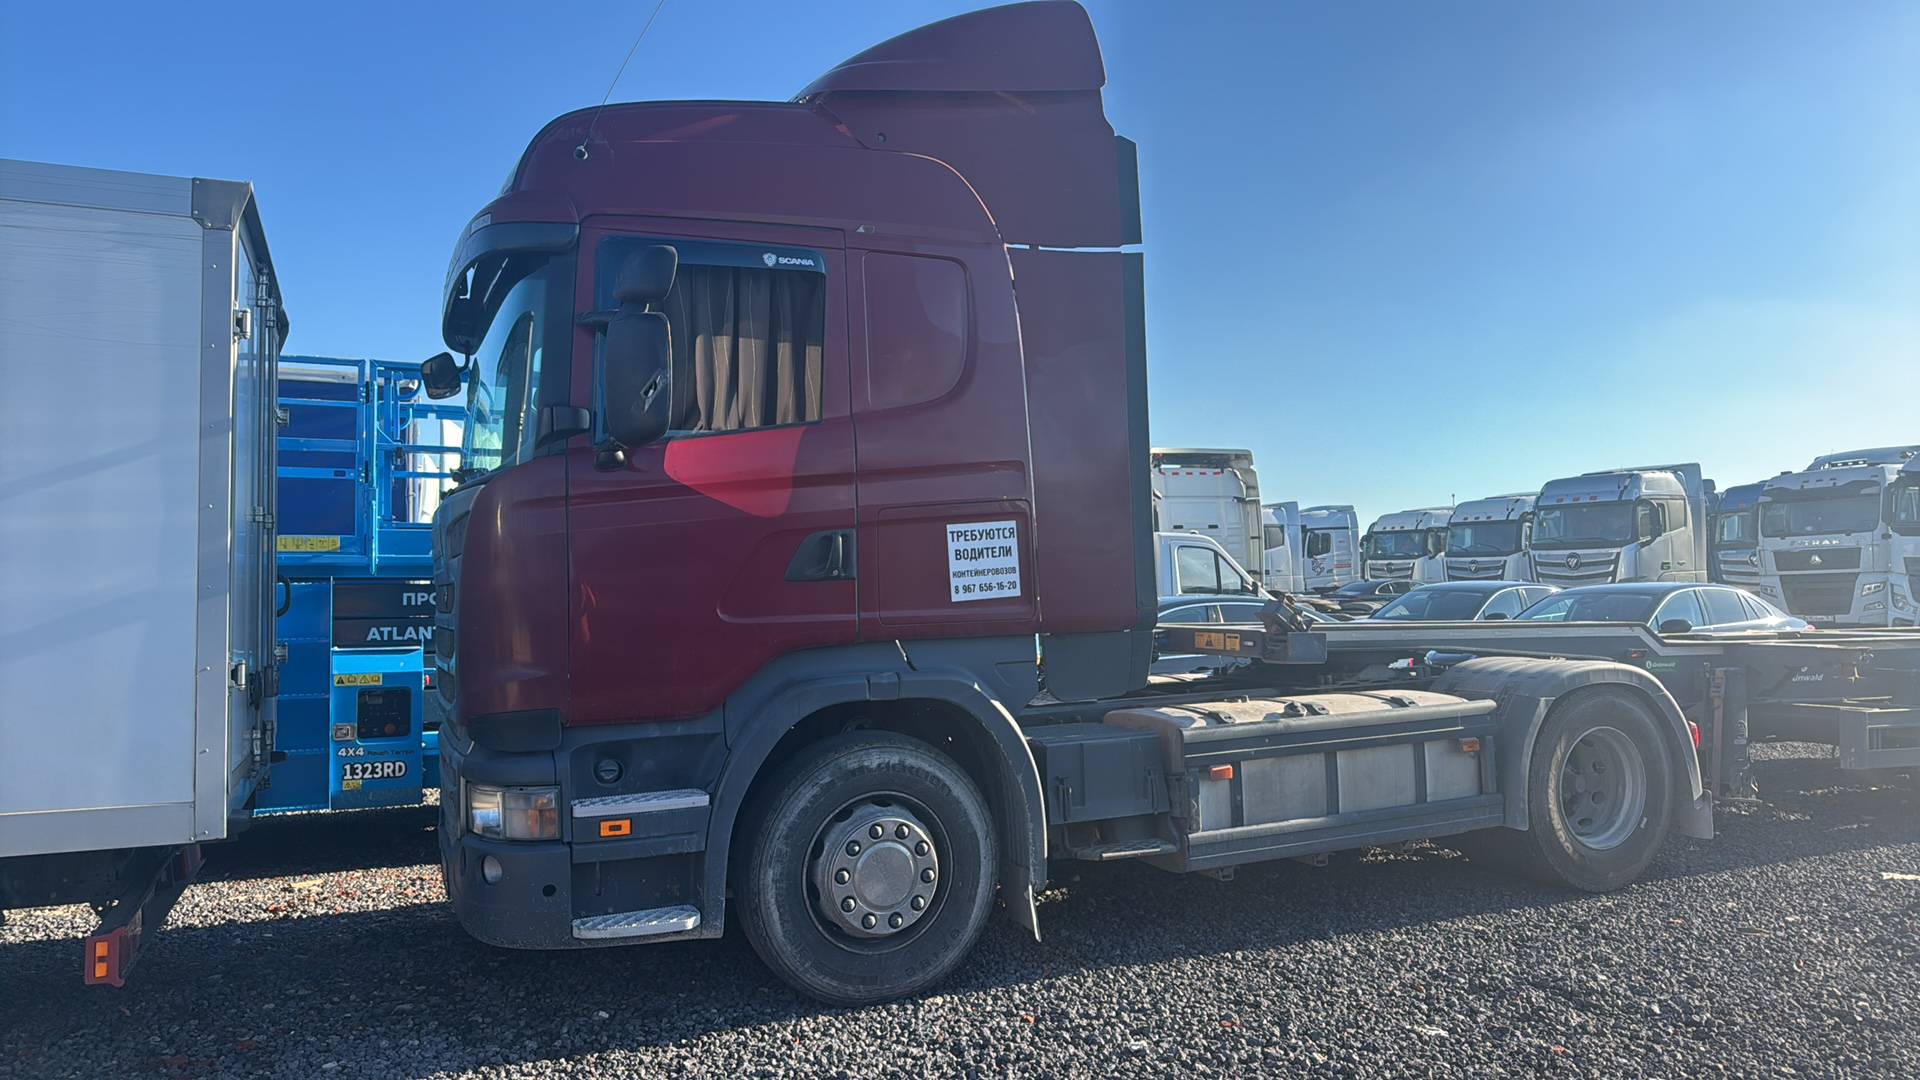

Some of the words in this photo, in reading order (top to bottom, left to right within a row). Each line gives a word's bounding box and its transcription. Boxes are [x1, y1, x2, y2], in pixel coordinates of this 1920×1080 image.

[778, 256, 815, 267] SCANIA
[949, 527, 1016, 543] ТРЕБУЮТСЯ
[954, 545, 1013, 562] ВОДИТЕЛИ
[952, 566, 1017, 579] КОНТЕЙНЕРОВОЗОВ
[954, 585, 960, 595] 8
[962, 583, 977, 594] 967
[978, 580, 1018, 593] 656-16-20
[366, 626, 437, 641] ATLAN
[343, 761, 406, 780] 1323RD
